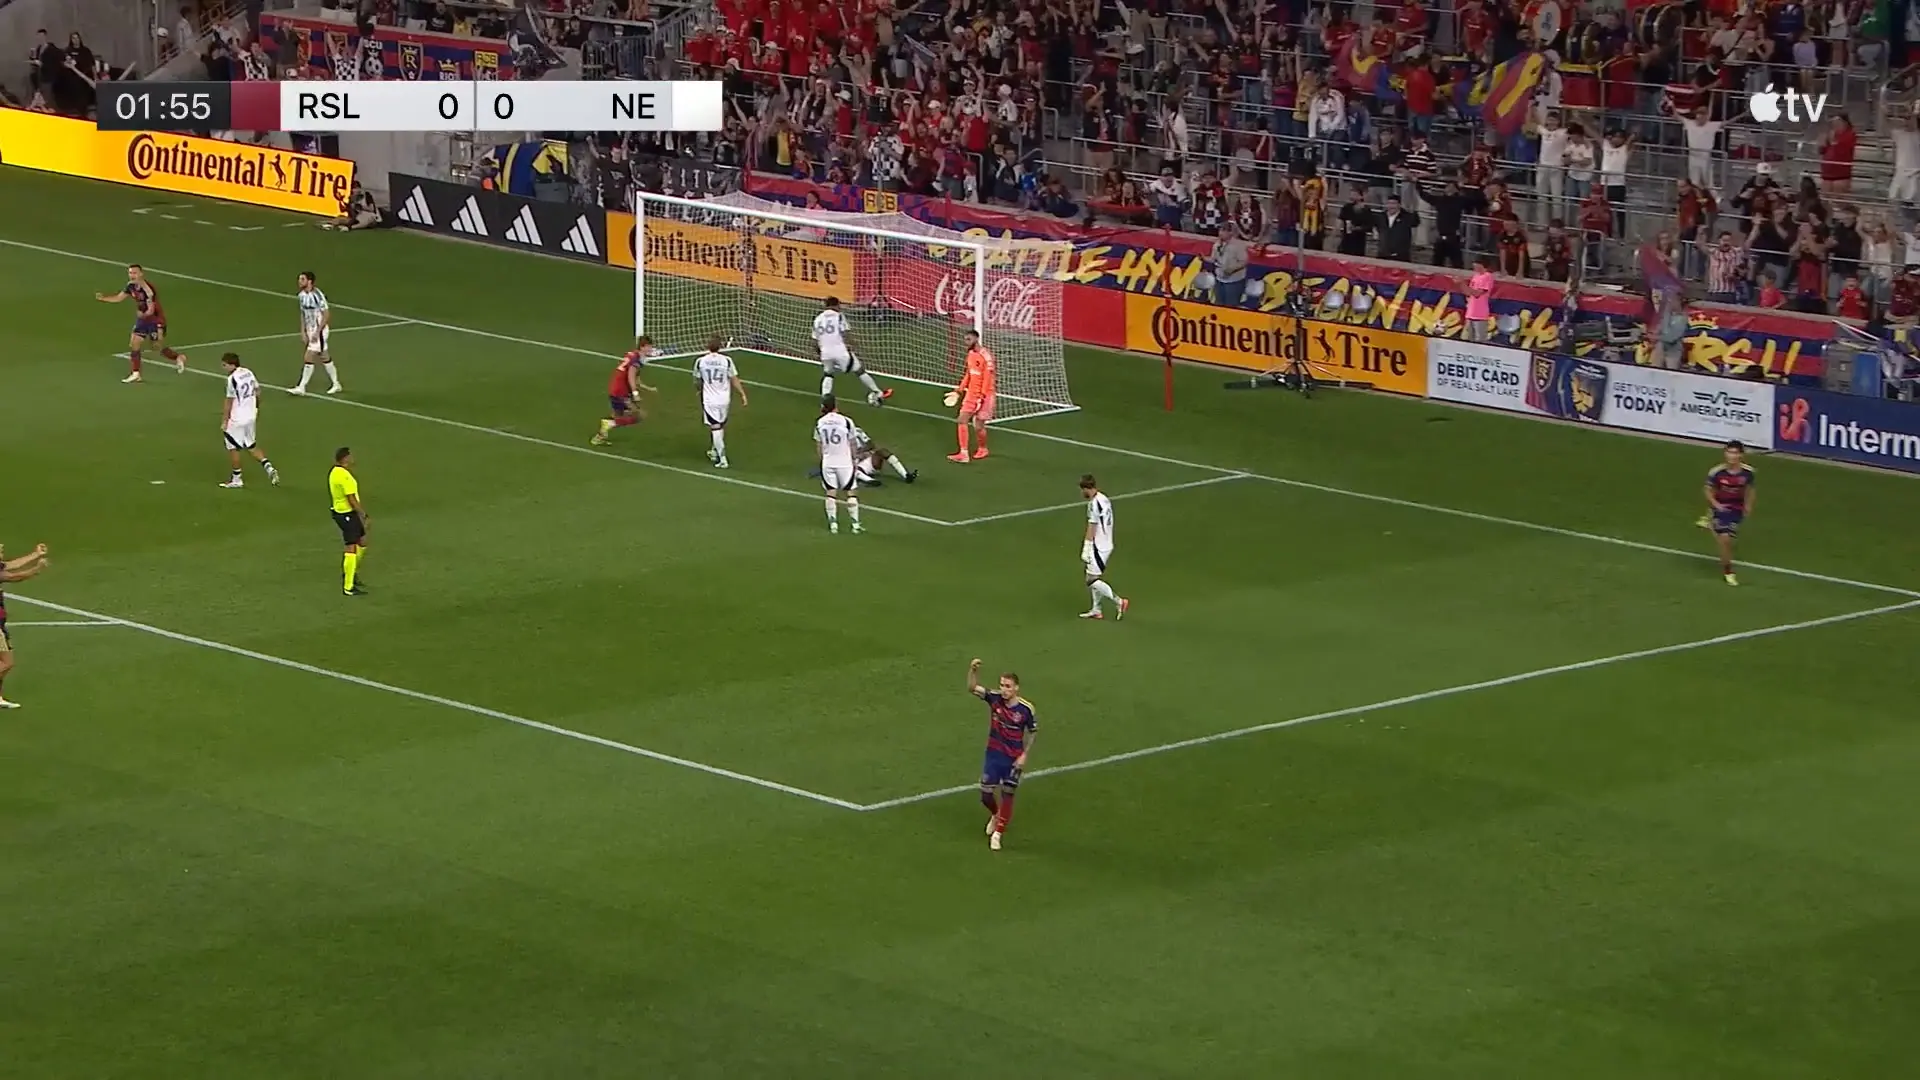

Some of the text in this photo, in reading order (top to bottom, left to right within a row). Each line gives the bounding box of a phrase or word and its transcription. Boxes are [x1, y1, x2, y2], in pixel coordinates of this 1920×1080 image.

[128, 133, 348, 201] Continental Tire
[629, 223, 838, 285] Continental Tire
[1152, 305, 1407, 376] Continental Tire
[705, 368, 724, 385] 14
[1437, 362, 1519, 386] DEBIT CARD
[1614, 395, 1666, 415] TODAY
[1680, 402, 1728, 418] AMERICA
[1730, 410, 1762, 424] FIRST
[822, 428, 841, 445] 16
[1819, 414, 1920, 460] Interm
